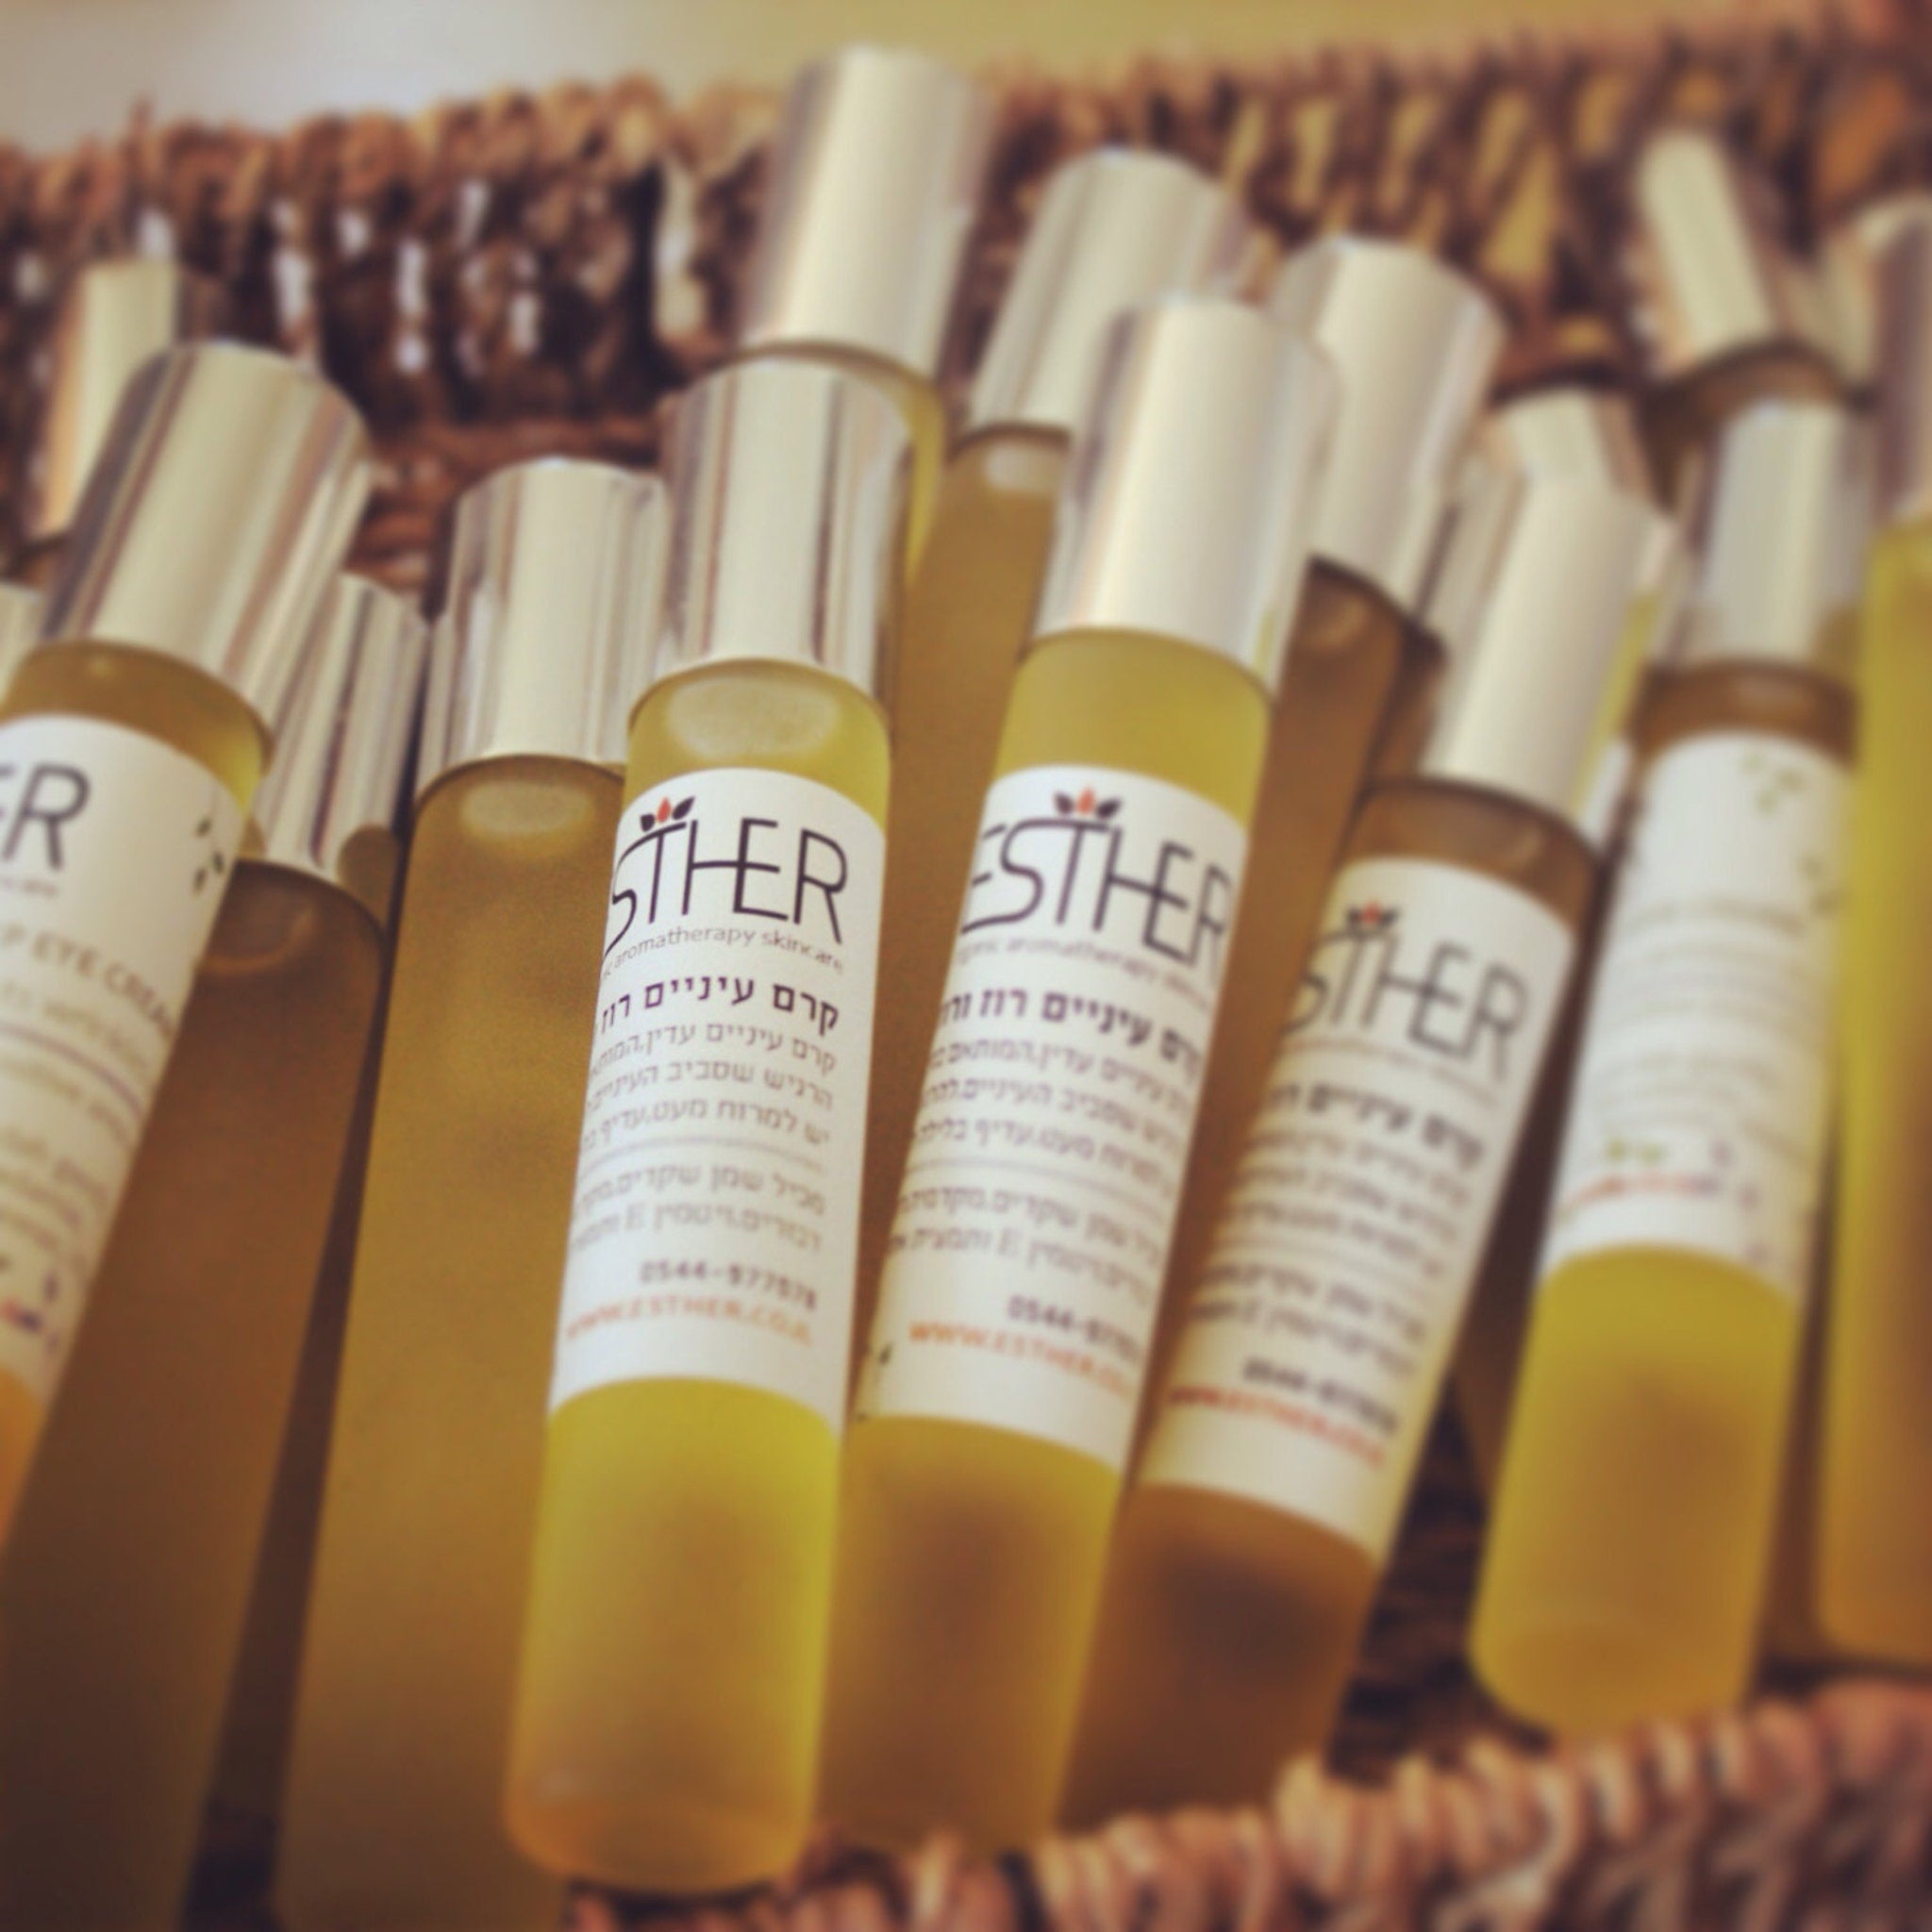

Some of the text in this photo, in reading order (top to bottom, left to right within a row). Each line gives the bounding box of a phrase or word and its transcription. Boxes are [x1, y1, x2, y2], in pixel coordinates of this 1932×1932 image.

[615, 925, 756, 968] aromatherapy
[643, 975, 756, 1010] עיניים
[772, 983, 841, 1037] קרם
[979, 988, 1028, 1018] רוז
[705, 1024, 785, 1051] עיניים
[1041, 991, 1154, 1047] עיניים
[666, 1060, 756, 1084] שסביב
[791, 1037, 837, 1077] קרם
